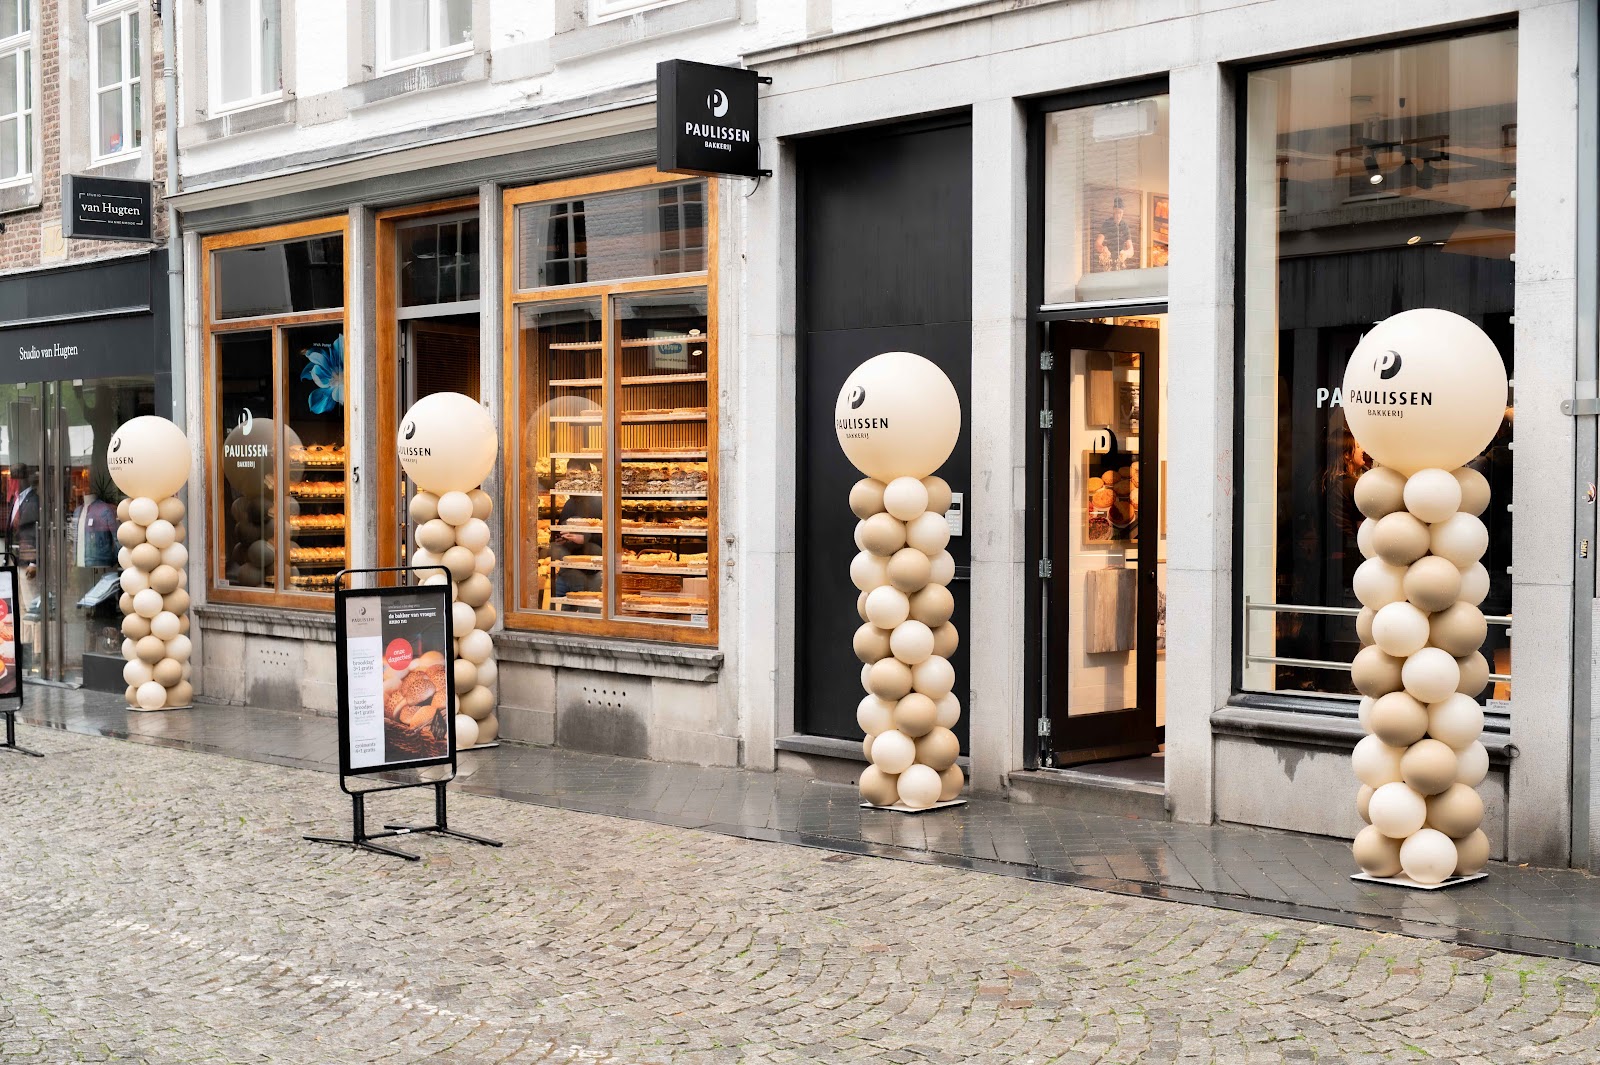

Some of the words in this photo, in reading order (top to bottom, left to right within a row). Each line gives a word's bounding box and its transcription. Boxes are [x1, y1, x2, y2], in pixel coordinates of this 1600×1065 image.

[685, 121, 750, 143] PAULISSEN
[704, 141, 732, 152] BAKKERIJ
[81, 203, 100, 213] van
[102, 202, 140, 217] Hugten
[19, 345, 40, 361] Studio
[41, 348, 53, 358] van
[53, 342, 78, 360] Hugten
[1350, 389, 1432, 406] PAULISSEN
[1367, 409, 1404, 419] BAKKERIJ
[224, 444, 268, 458] PAULISSEN
[236, 460, 256, 469] BAKKERIJ
[352, 466, 361, 483] 5
